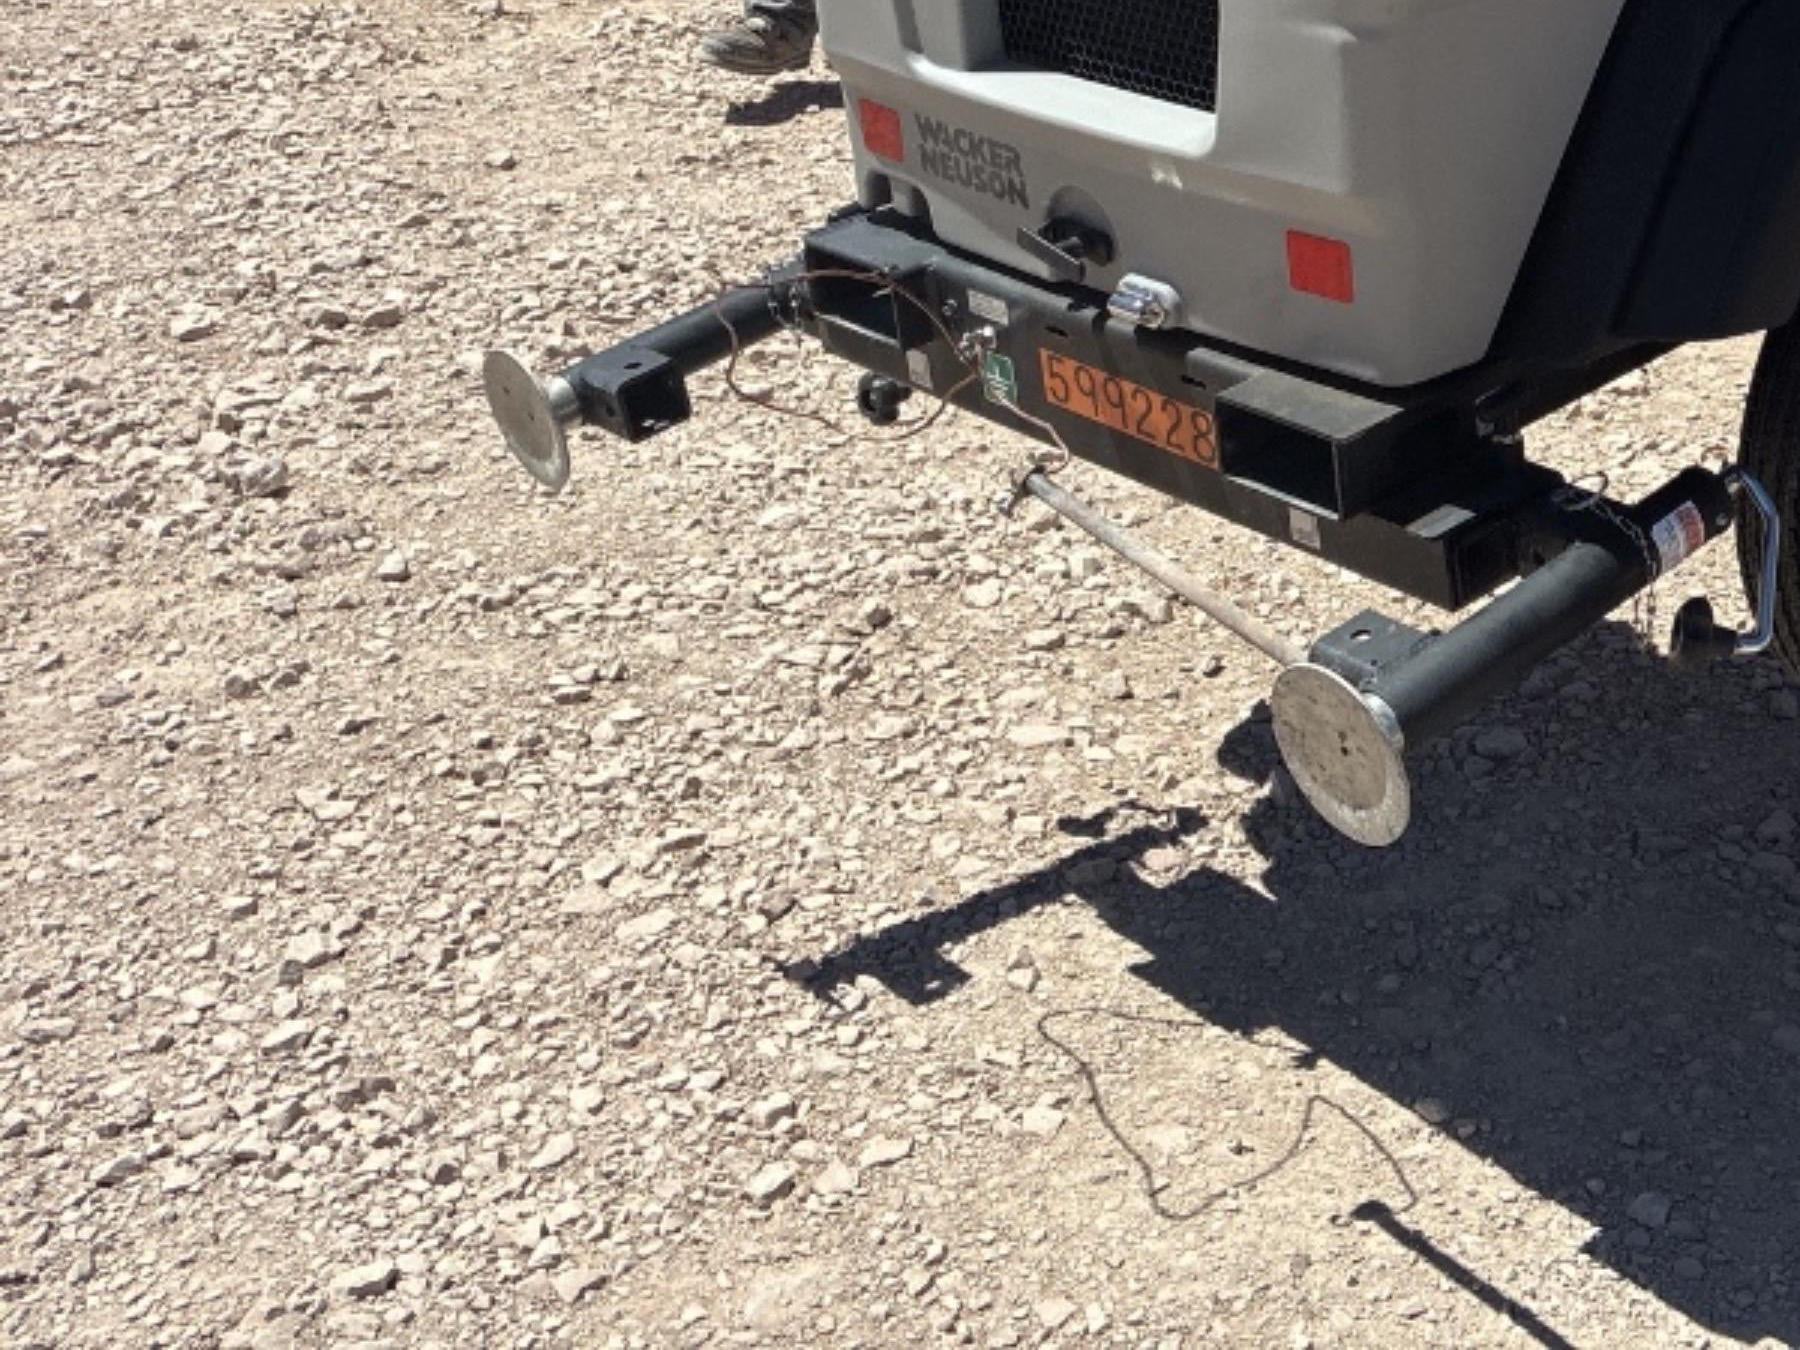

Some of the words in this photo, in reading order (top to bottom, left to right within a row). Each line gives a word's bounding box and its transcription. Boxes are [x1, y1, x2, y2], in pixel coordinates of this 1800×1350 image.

[914, 113, 1023, 178] WACKER
[918, 143, 1029, 209] NEUSON
[1047, 354, 1216, 463] 599228
